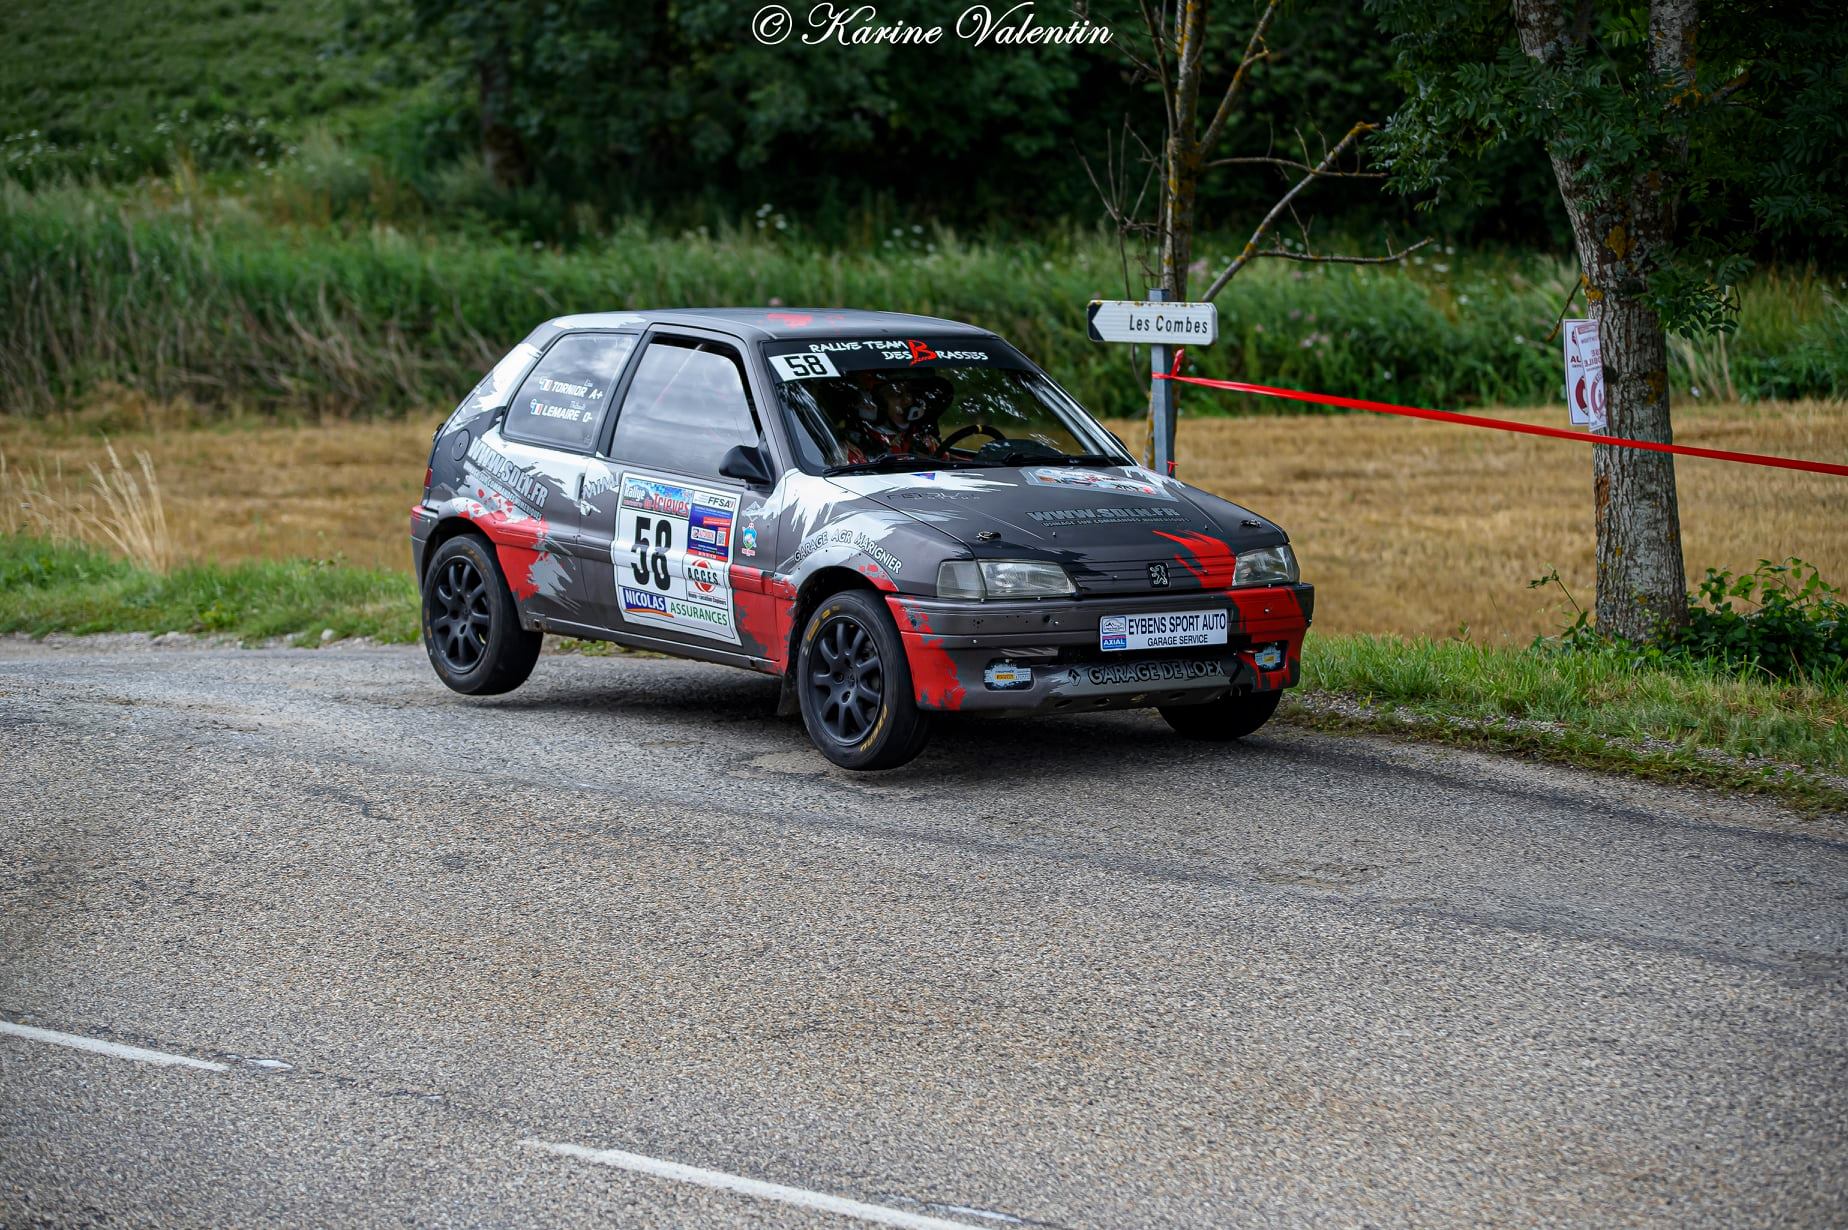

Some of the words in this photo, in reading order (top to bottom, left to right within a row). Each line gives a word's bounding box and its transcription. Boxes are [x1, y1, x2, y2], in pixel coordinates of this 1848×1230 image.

[1129, 314, 1151, 331] Les
[1155, 315, 1208, 334] Combes
[808, 341, 862, 353] RALLYE
[862, 340, 908, 351] TEAM
[883, 350, 913, 361] DES
[783, 354, 828, 378] 58
[541, 405, 581, 421] LEMAIRE
[707, 496, 731, 508] FFSA
[630, 515, 672, 591] 58
[794, 531, 828, 562] GARAGE
[854, 532, 902, 574] MARIGNIER
[624, 588, 666, 611] NICOLAS
[670, 601, 728, 627] ASSURANCES
[1128, 616, 1167, 635] EYBENS
[1169, 614, 1200, 633] SPORT
[1201, 612, 1227, 631] AUTO
[1147, 635, 1178, 647] GARAGE
[1179, 634, 1208, 645] SERVICE
[1088, 663, 1161, 685] GARAGE
[1162, 662, 1183, 680] DE
